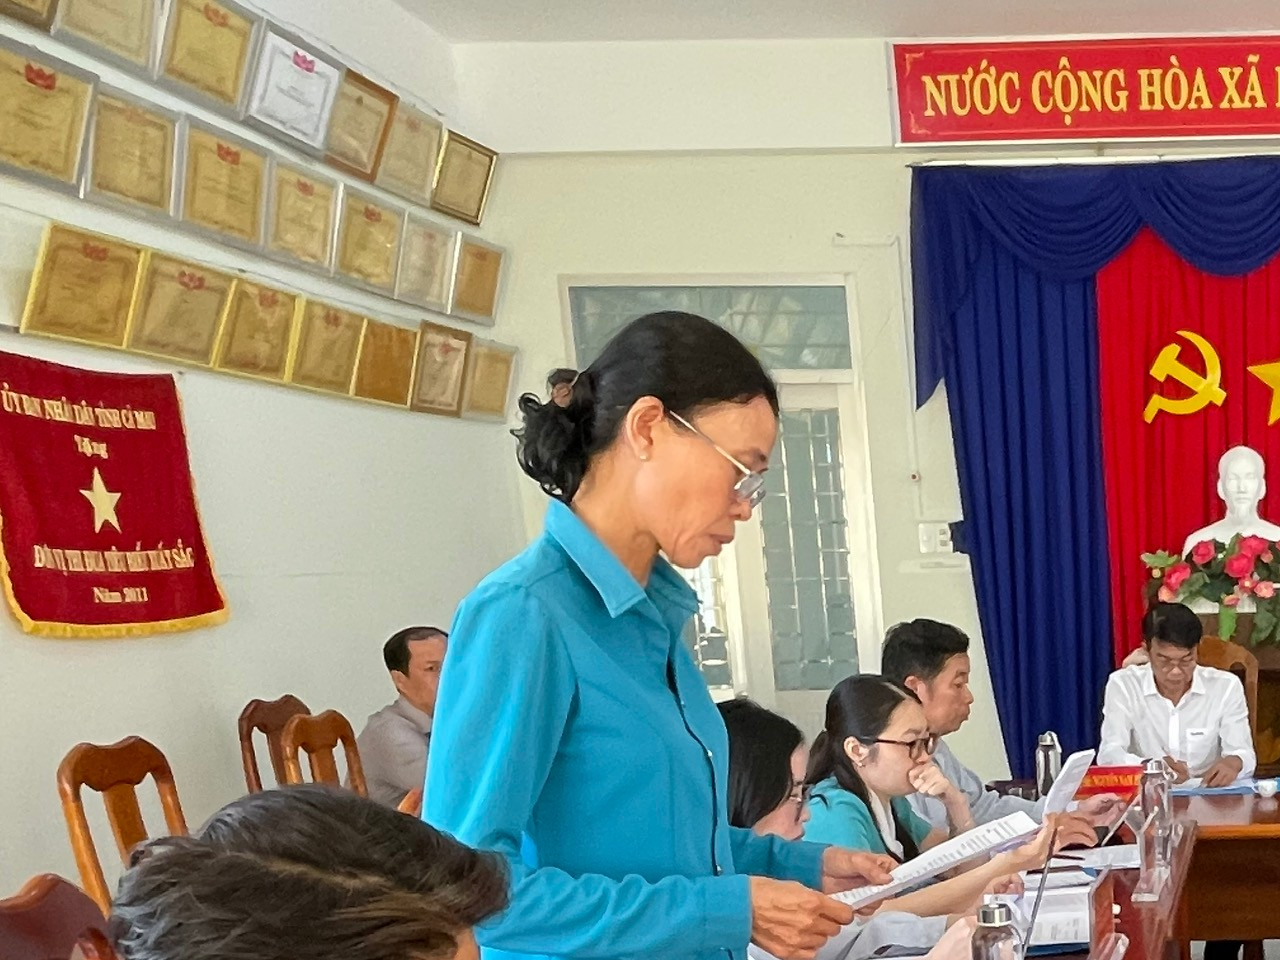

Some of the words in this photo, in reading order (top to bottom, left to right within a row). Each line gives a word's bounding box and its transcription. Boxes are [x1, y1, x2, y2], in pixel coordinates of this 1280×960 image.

[922, 59, 1020, 117] NƯỚC
[1031, 56, 1128, 125] CỘNG
[1138, 54, 1213, 111] HÒA
[1218, 54, 1267, 109] XÃ
